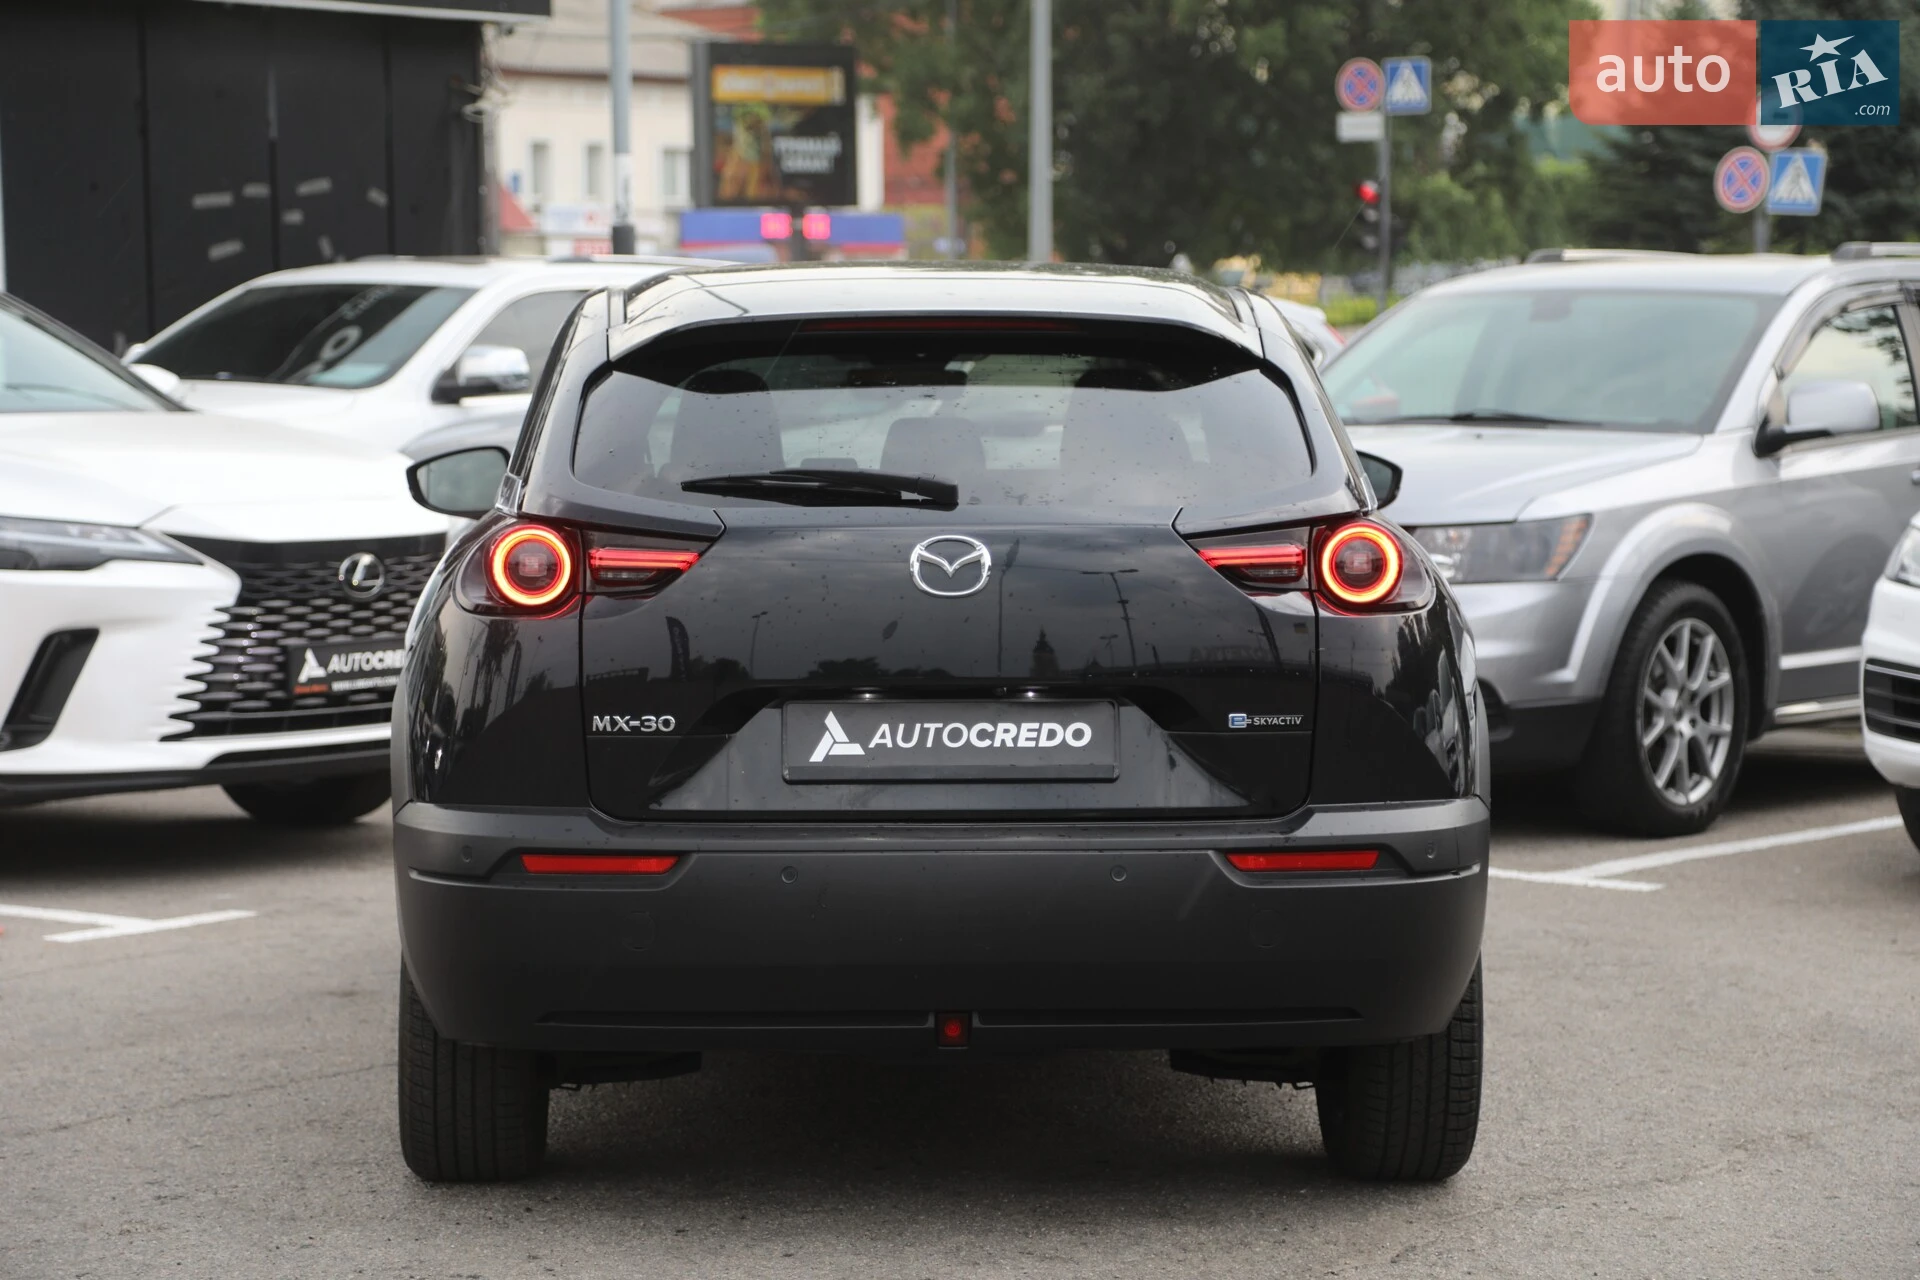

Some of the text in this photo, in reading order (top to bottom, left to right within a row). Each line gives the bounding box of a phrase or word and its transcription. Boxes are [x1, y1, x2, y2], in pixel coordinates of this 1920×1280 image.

[326, 648, 405, 674] AUTOCRE
[592, 715, 676, 732] MX-30
[868, 722, 1092, 748] AUTOCREDO
